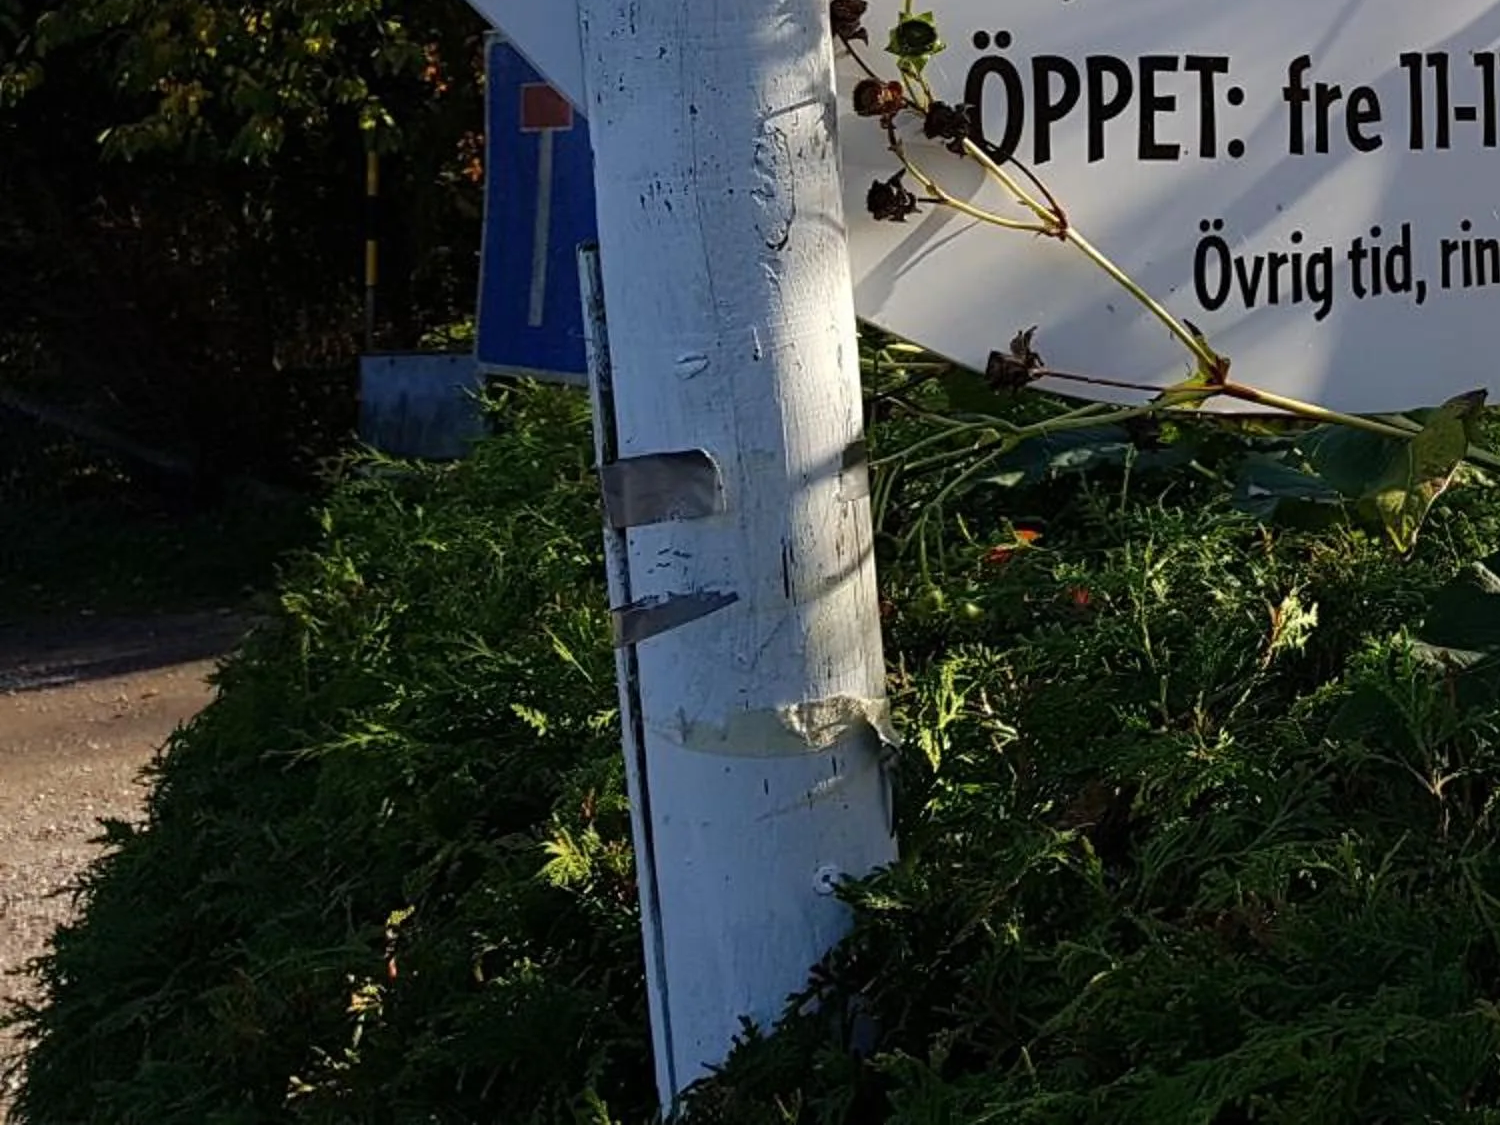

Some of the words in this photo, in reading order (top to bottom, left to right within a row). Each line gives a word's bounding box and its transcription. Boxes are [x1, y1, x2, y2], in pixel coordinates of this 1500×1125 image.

[964, 30, 1245, 165] ÖPPET:
[1282, 54, 1383, 155] fre
[1194, 218, 1333, 321] Övrig
[1347, 222, 1426, 305] tid,
